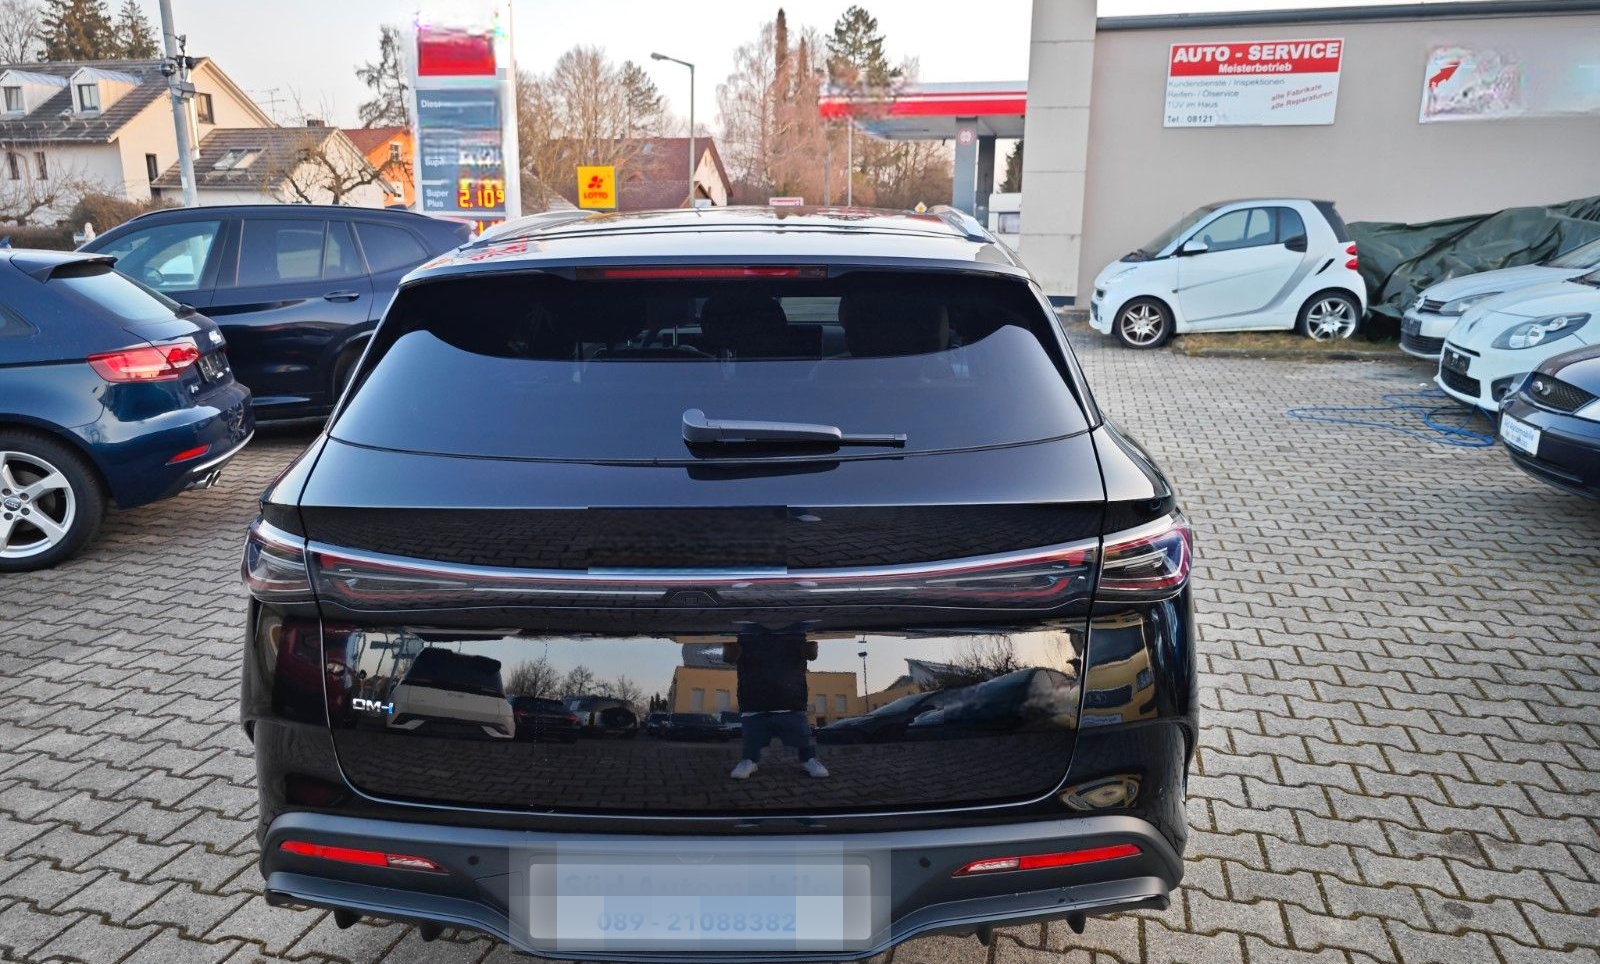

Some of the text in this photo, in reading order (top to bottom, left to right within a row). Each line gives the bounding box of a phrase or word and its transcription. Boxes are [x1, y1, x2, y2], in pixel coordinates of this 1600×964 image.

[1173, 46, 1230, 63] AUTO
[1248, 42, 1340, 60] SERVICE
[1218, 62, 1292, 74] Meisterbetrieb
[1168, 80, 1226, 88] Kundendienste
[1234, 78, 1285, 87] Inspektionen
[1202, 89, 1239, 98] Ölservice
[426, 189, 448, 199] Super
[427, 199, 444, 208] Plus
[597, 911, 645, 932] 089
[667, 911, 796, 933] 21088382
